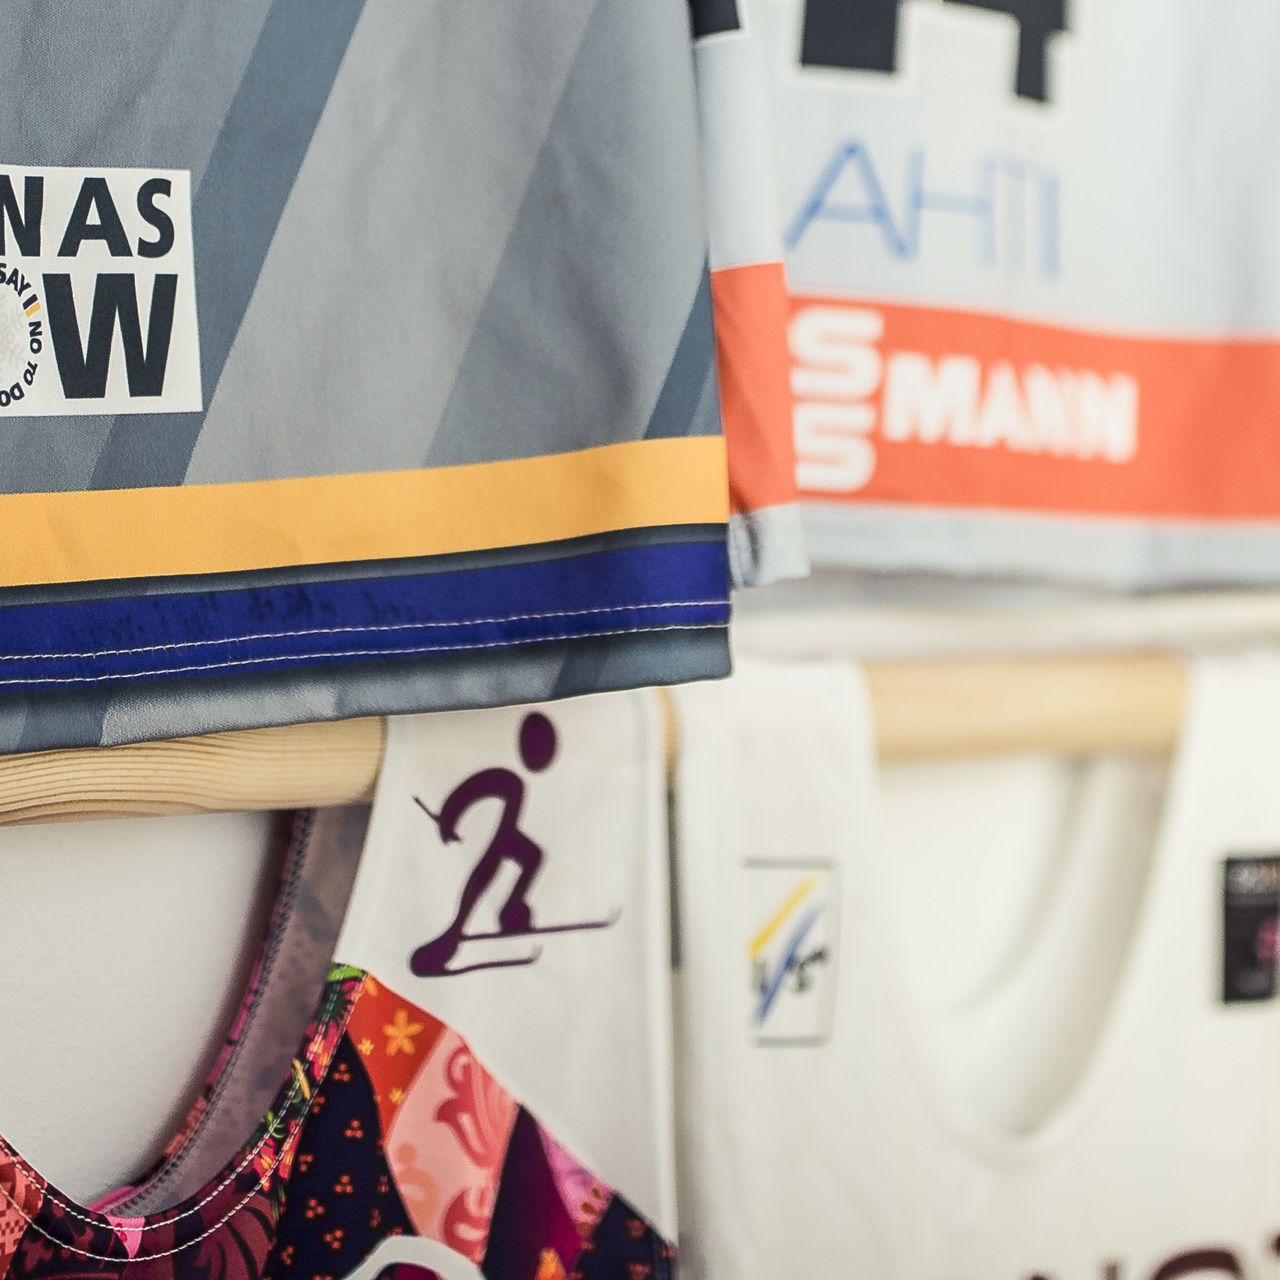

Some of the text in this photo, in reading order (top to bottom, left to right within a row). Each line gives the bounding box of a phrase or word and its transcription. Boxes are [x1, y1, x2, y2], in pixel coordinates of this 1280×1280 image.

[56, 176, 176, 259] AS
[28, 320, 43, 354] NO
[23, 361, 38, 386] TO
